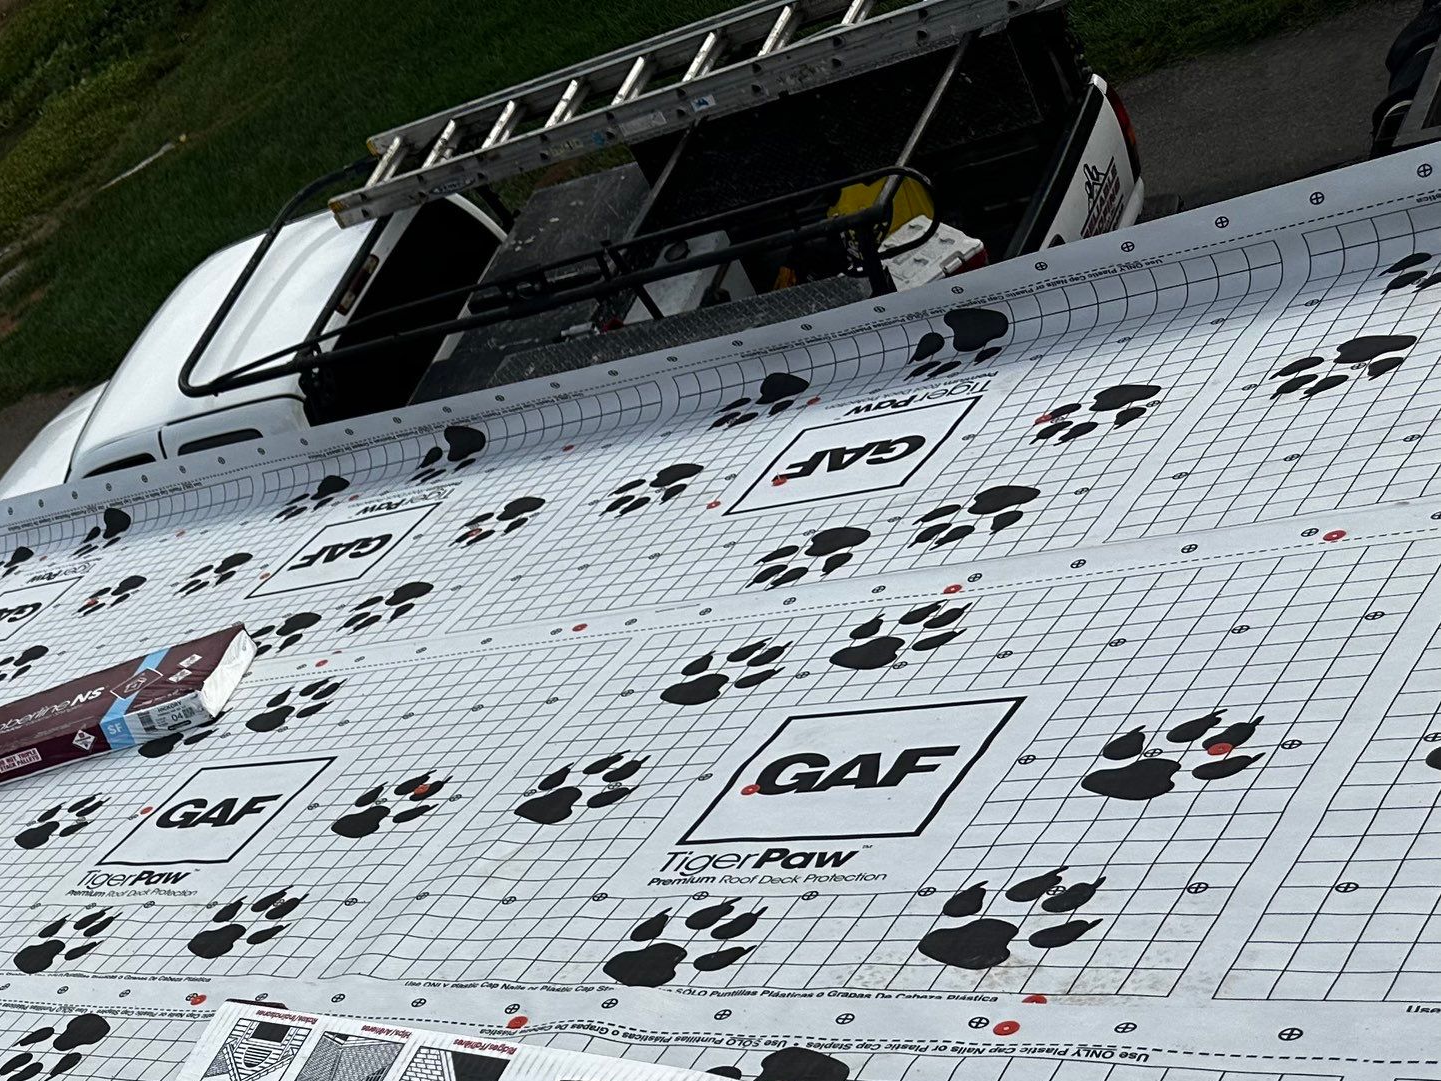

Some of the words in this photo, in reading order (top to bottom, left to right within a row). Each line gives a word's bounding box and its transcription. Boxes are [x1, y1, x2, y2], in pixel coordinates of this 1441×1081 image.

[1118, 261, 1143, 272] ONLY
[844, 378, 992, 417] TigerPaw
[772, 434, 927, 480] GAF
[288, 533, 394, 571] GAF
[107, 722, 124, 736] SF
[757, 745, 961, 796] GAF
[155, 794, 283, 829] GAF
[654, 845, 860, 876] TigerPaw
[76, 868, 191, 889] TigerPaw
[648, 875, 717, 887] Premium
[717, 874, 760, 886] Roof
[760, 873, 802, 885] Deck
[802, 870, 887, 884] Protection
[539, 983, 572, 993] Plastic
[709, 988, 758, 998] Puntillas
[611, 1027, 621, 1037] o
[621, 1030, 672, 1044] Plásticas
[673, 1034, 725, 1045] Puntillas
[726, 1037, 763, 1047] SÓLO
[763, 1038, 788, 1049] Use
[805, 1041, 852, 1051] Staples
[856, 1041, 882, 1051] Cap
[884, 1042, 929, 1053] Plastic
[951, 1044, 985, 1055] Nails
[986, 1045, 1012, 1055] Cap
[1020, 1045, 1070, 1057] Plastic
[1073, 1048, 1115, 1060] ONLY
[1119, 1050, 1150, 1063] Use
